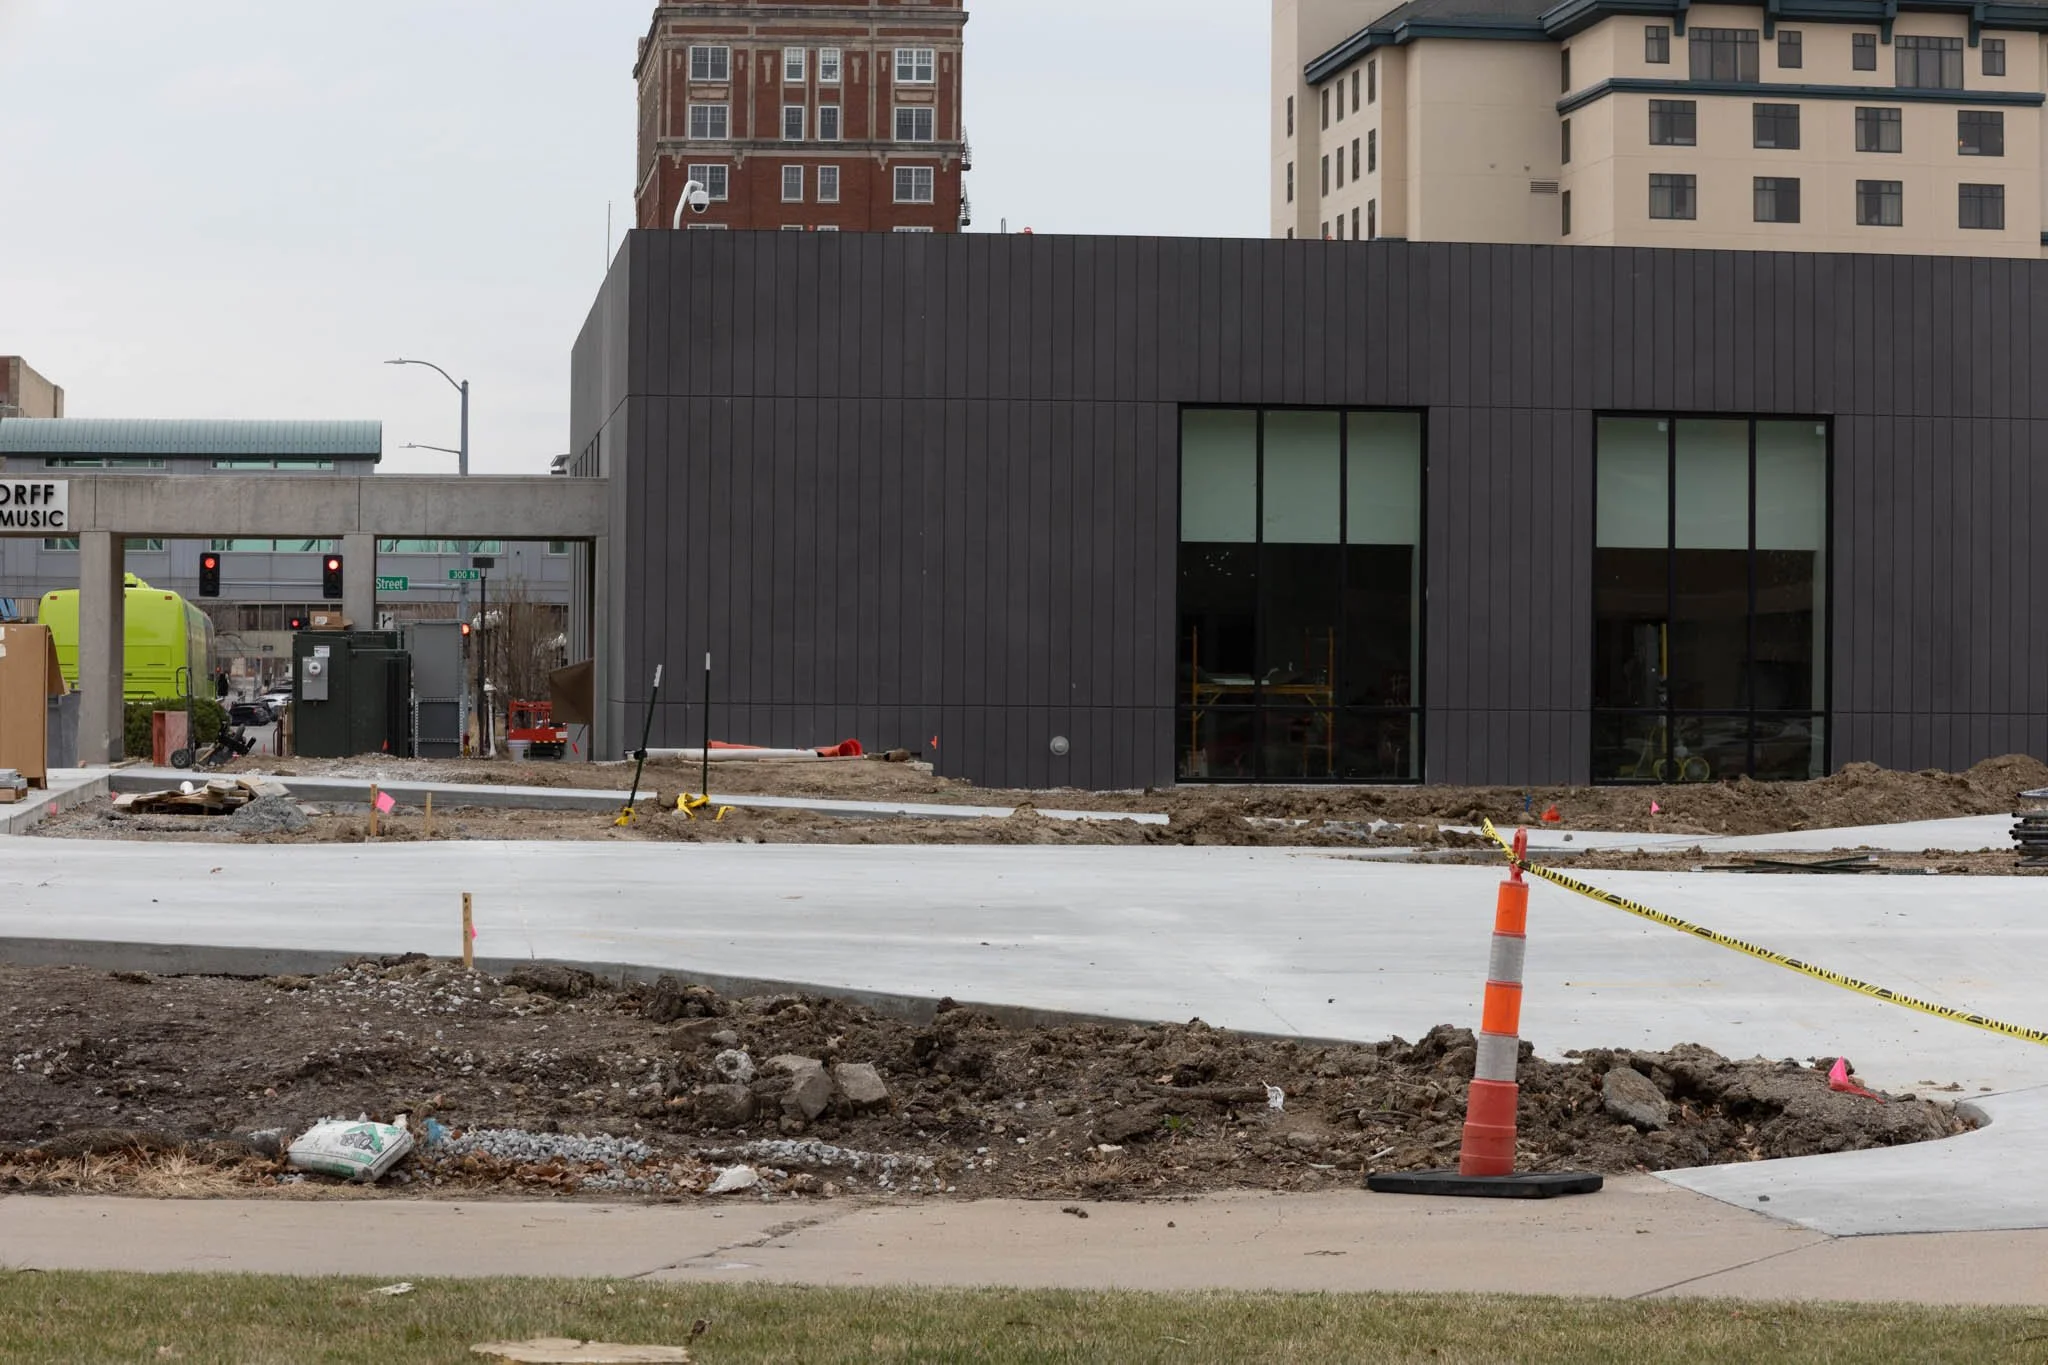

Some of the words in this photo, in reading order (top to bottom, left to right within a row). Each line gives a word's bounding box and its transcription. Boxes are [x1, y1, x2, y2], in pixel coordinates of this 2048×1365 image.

[0, 510, 64, 527] MUSIC
[453, 571, 467, 579] 300
[376, 578, 403, 590] Street
